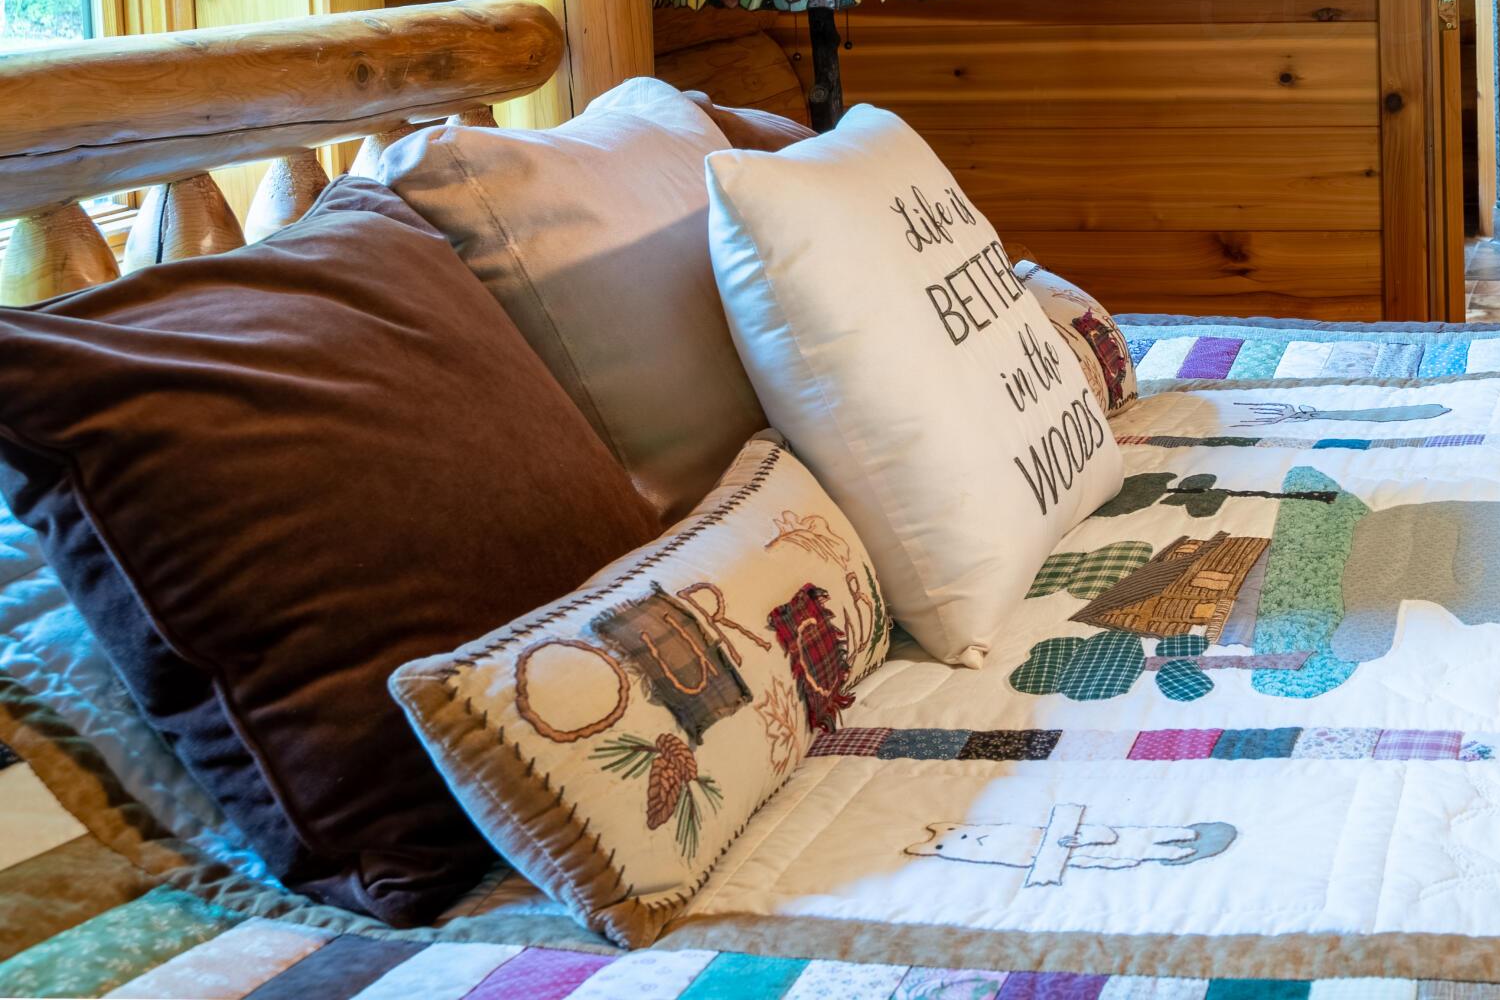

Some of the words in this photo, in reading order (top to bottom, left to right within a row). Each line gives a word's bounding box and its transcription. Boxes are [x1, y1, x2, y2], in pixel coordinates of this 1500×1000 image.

[890, 185, 953, 252] Life
[945, 187, 976, 226] is
[925, 240, 1029, 346] BETTER
[1000, 367, 1038, 412] in
[1018, 323, 1062, 391] the
[1013, 388, 1105, 516] WOODS
[515, 582, 772, 743] OUR
